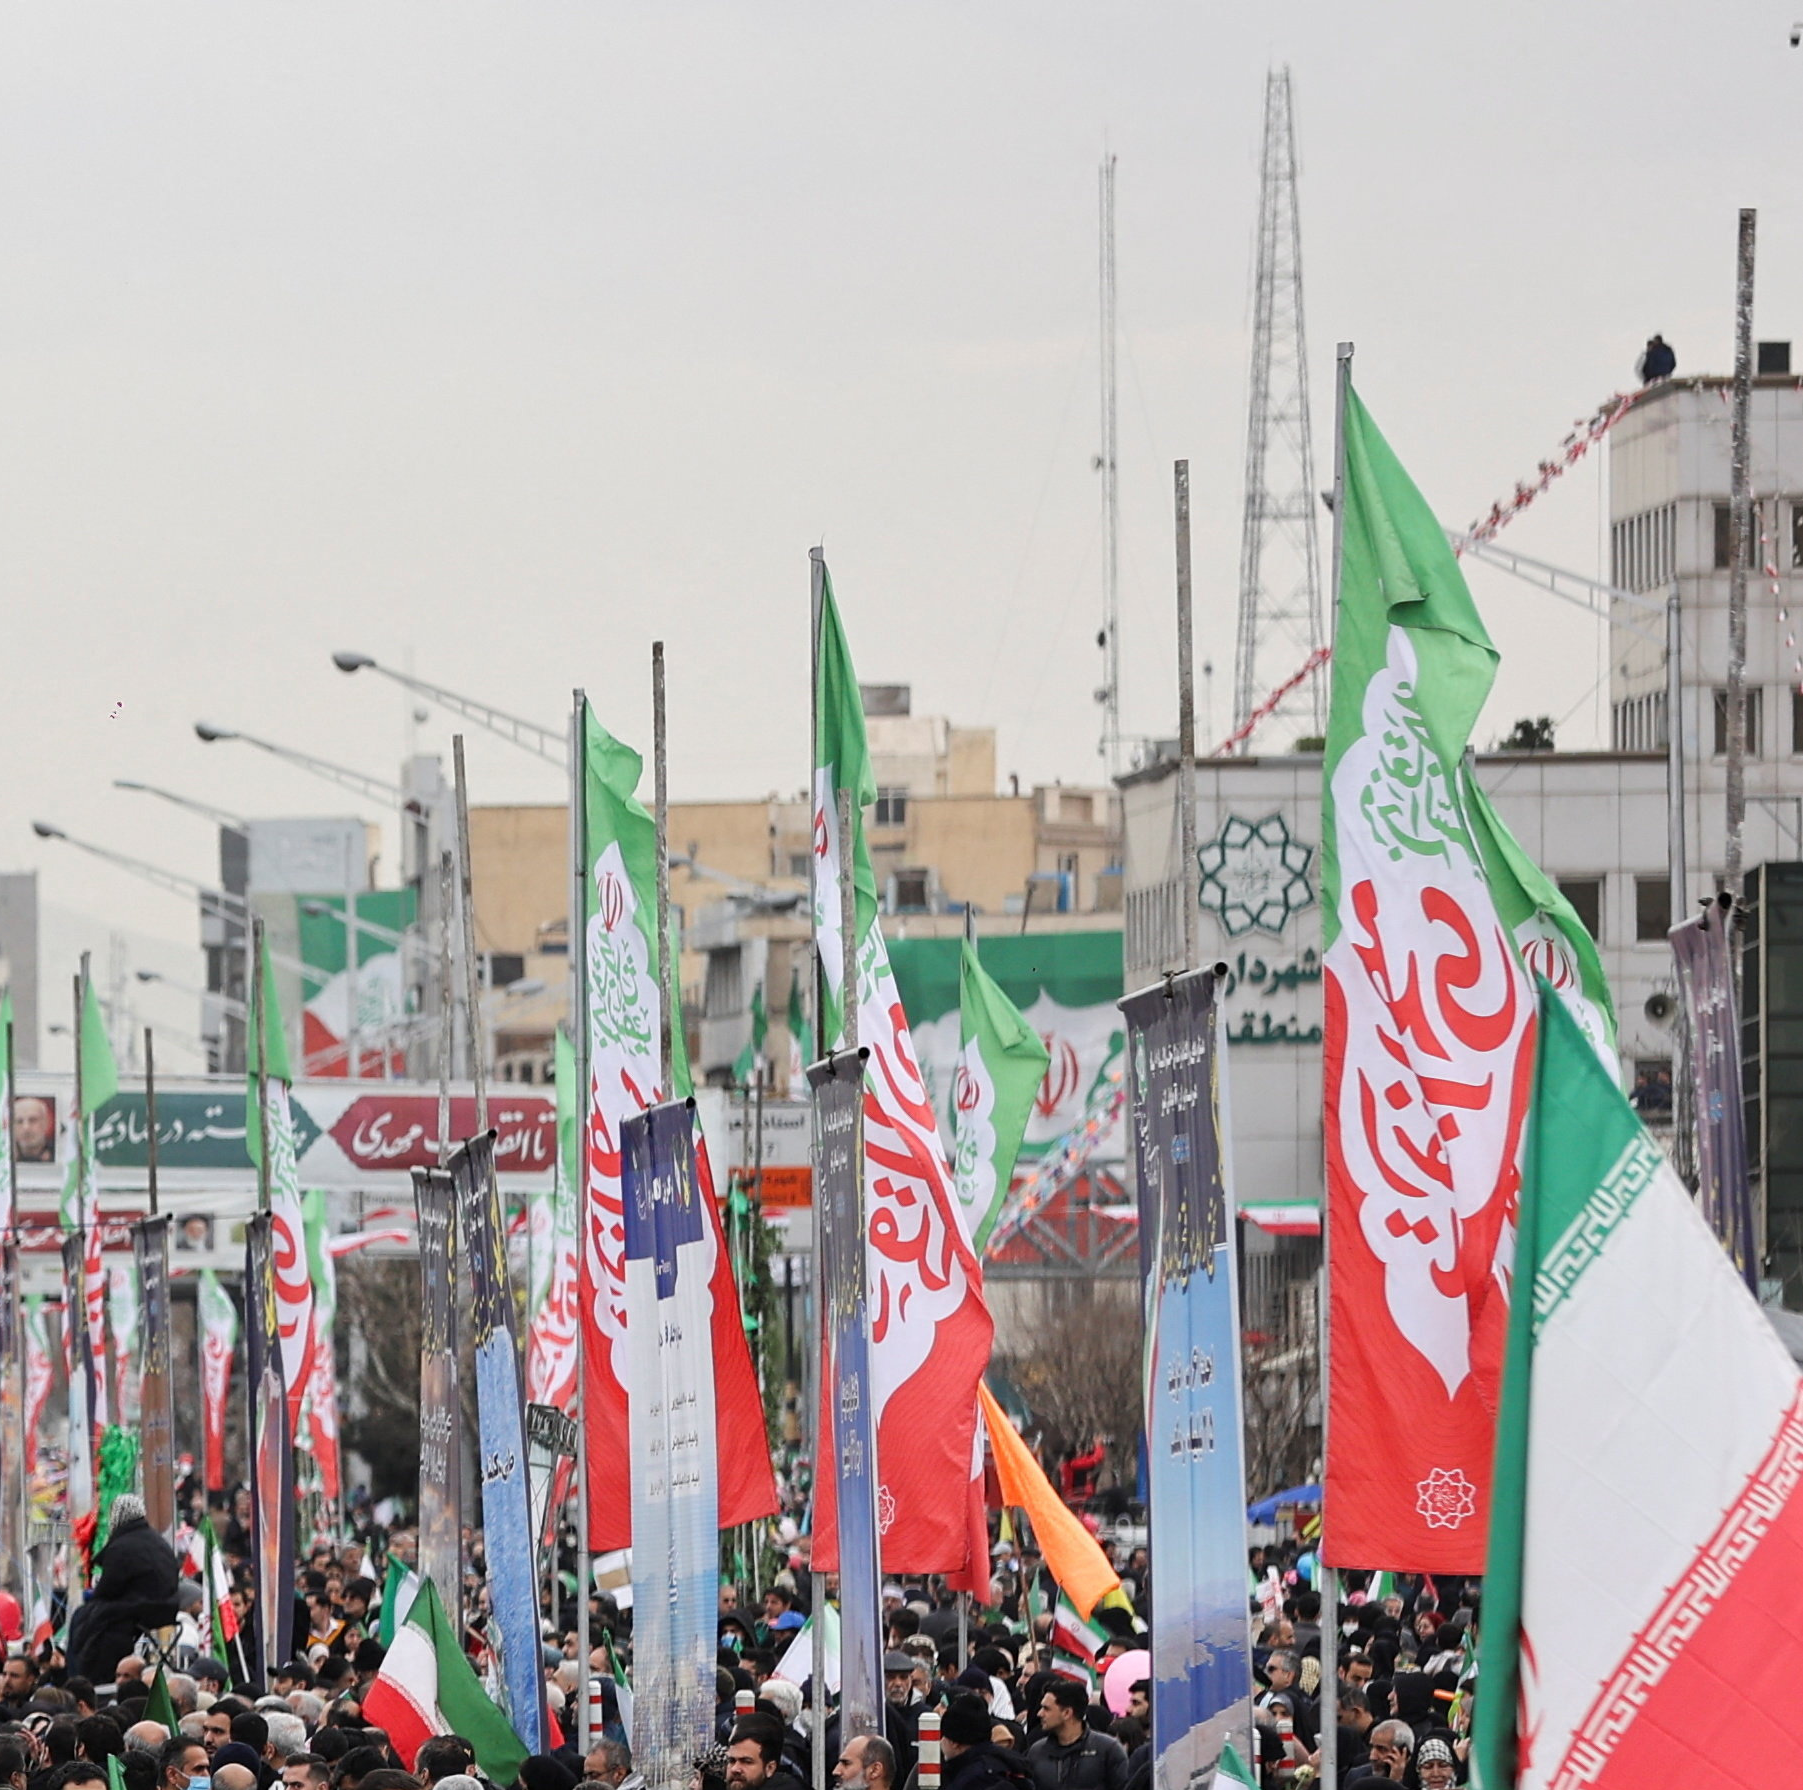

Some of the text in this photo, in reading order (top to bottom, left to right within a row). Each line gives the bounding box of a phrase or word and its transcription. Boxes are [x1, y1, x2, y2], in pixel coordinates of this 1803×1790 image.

[1225, 947, 1322, 995] شهردار
[159, 1117, 184, 1145] در
[351, 1110, 424, 1160] مهدی
[423, 1110, 531, 1161] انقب
